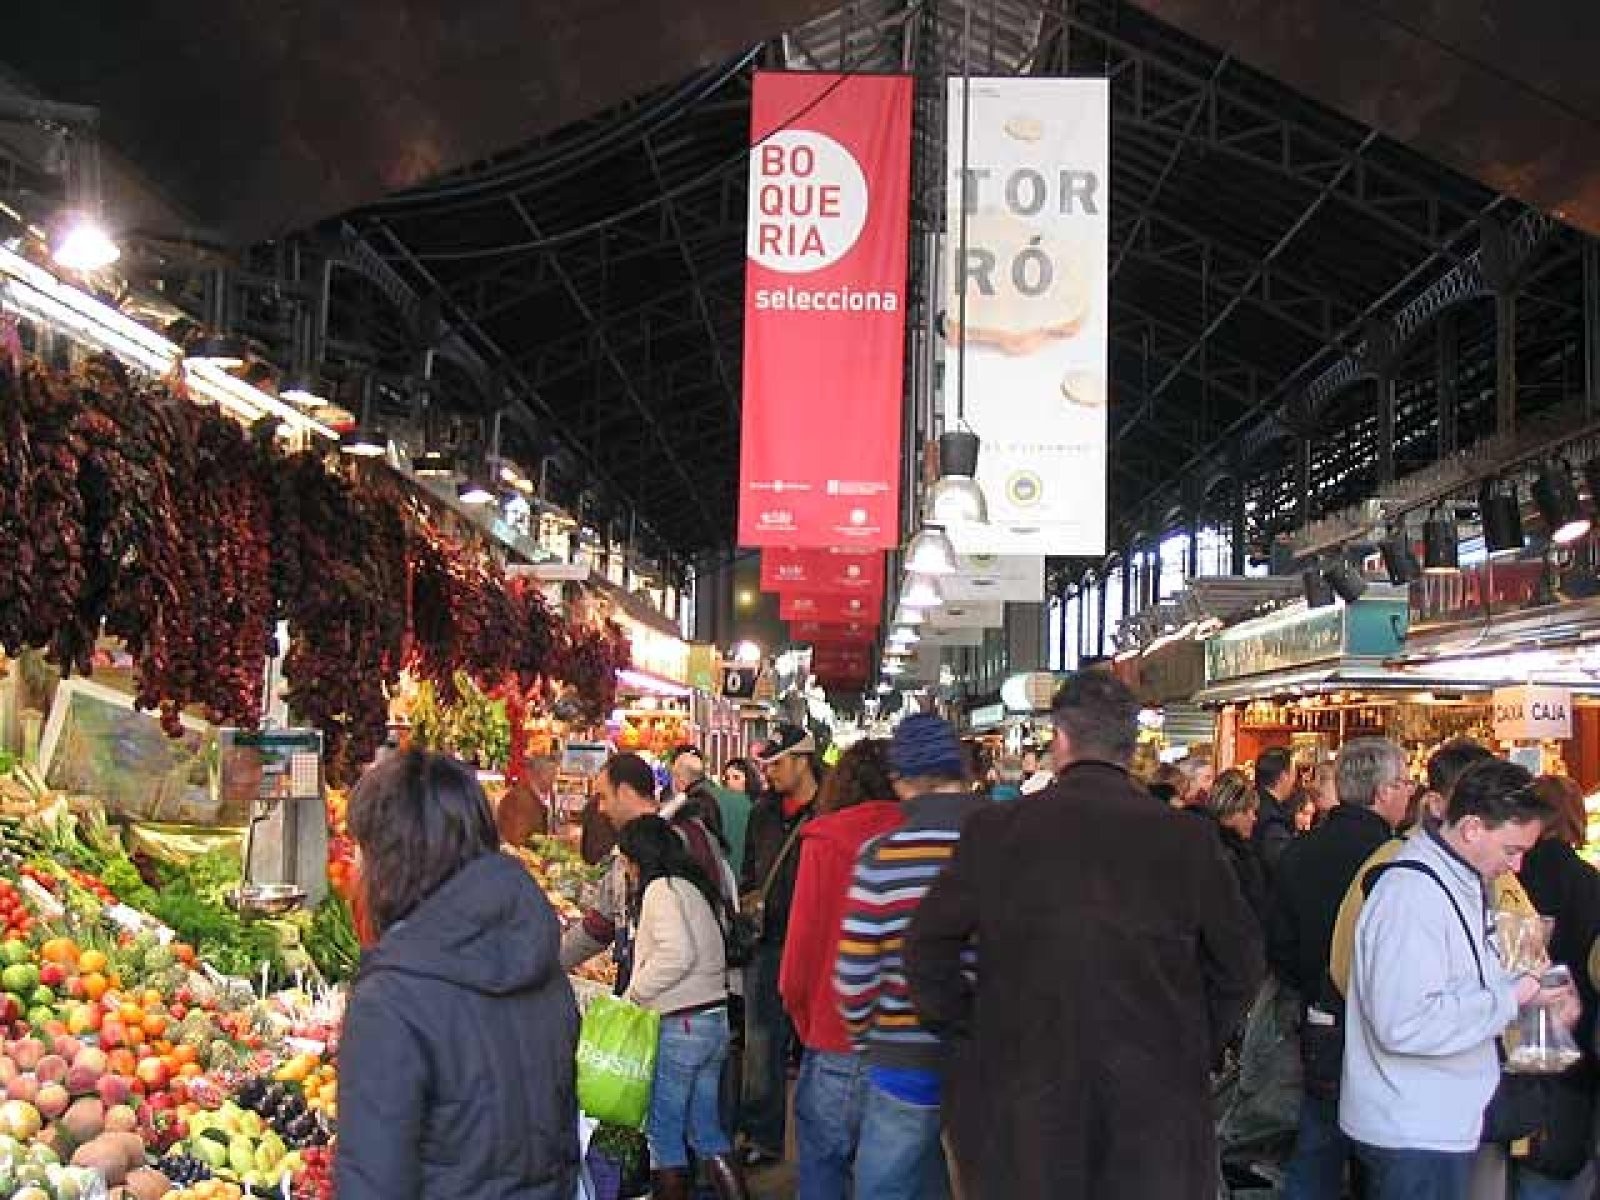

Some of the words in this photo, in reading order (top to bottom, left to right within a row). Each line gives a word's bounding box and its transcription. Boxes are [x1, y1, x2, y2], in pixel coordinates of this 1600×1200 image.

[761, 144, 815, 178] BO
[759, 184, 841, 218] QUE
[953, 167, 1099, 216] TOR
[758, 224, 826, 256] RIA
[953, 234, 1053, 296] RÓ
[755, 285, 898, 311] selecciona
[1531, 702, 1566, 721] CAJA
